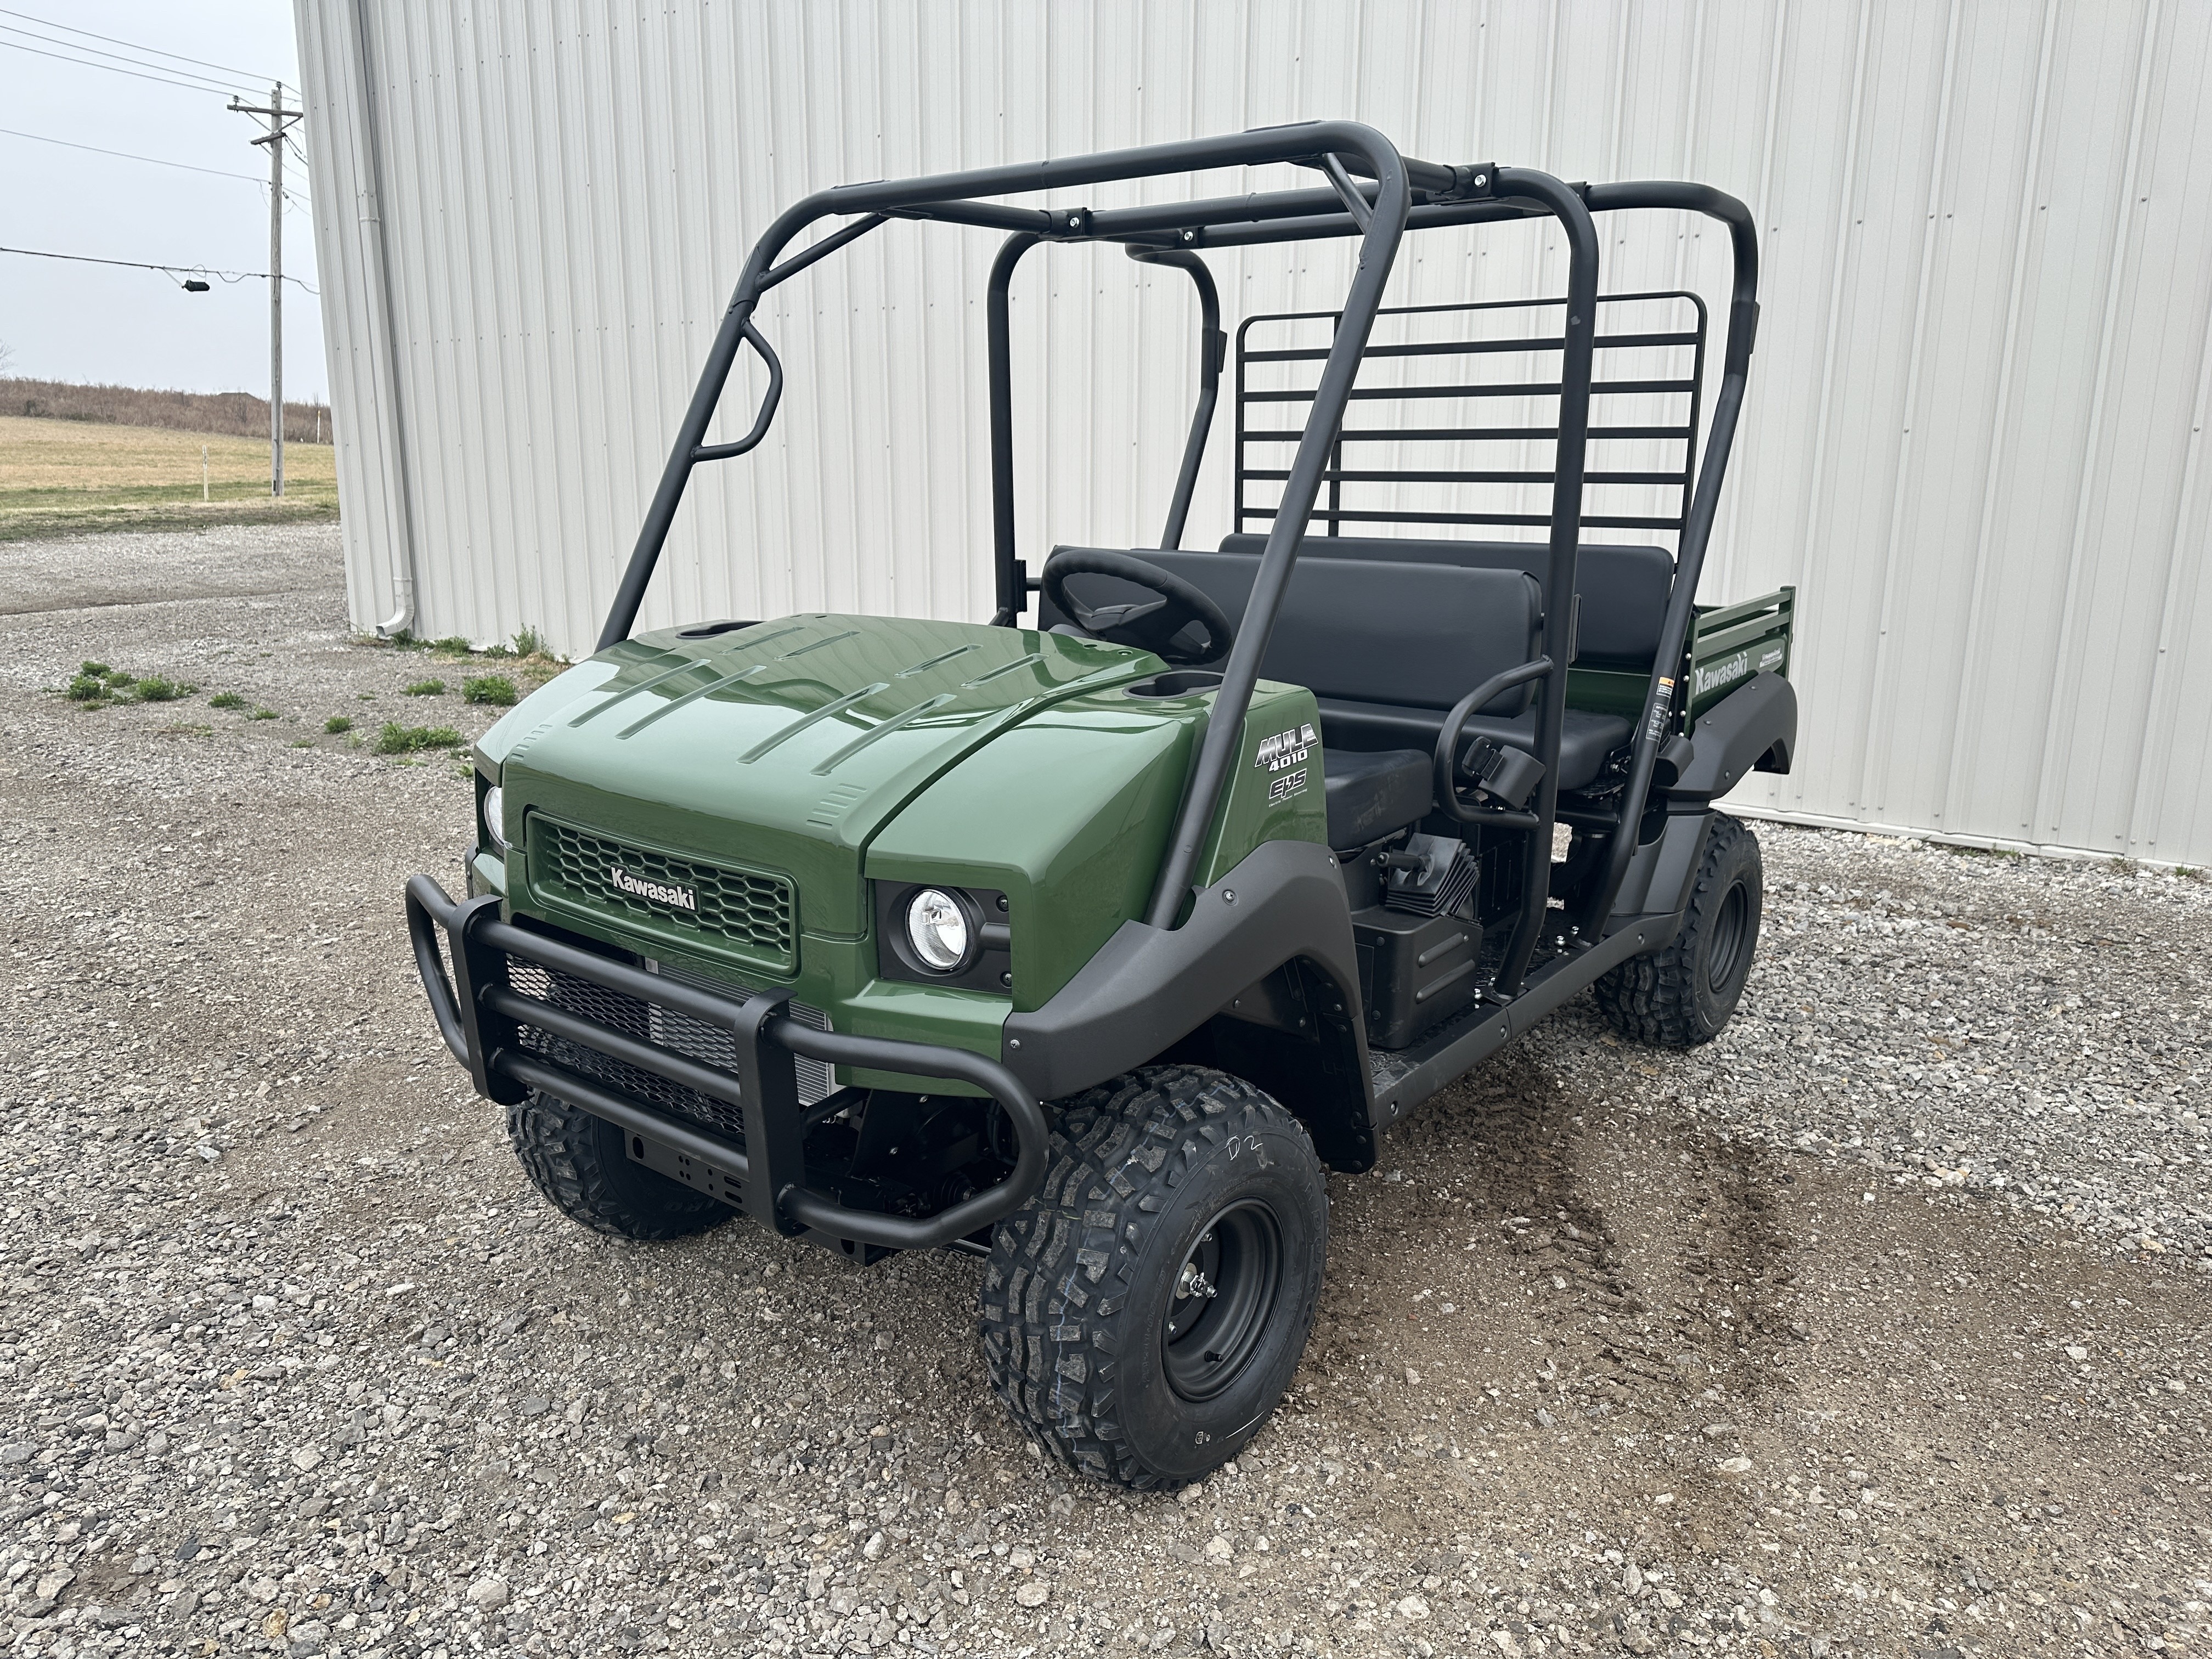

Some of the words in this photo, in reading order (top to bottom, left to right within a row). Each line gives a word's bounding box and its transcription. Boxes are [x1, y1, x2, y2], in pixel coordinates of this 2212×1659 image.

[1694, 651, 1748, 696] Kawasaki
[1254, 723, 1319, 768] MULE
[1268, 748, 1308, 772] 4010
[1268, 768, 1307, 800] EPS
[611, 866, 696, 911] Kawasaki
